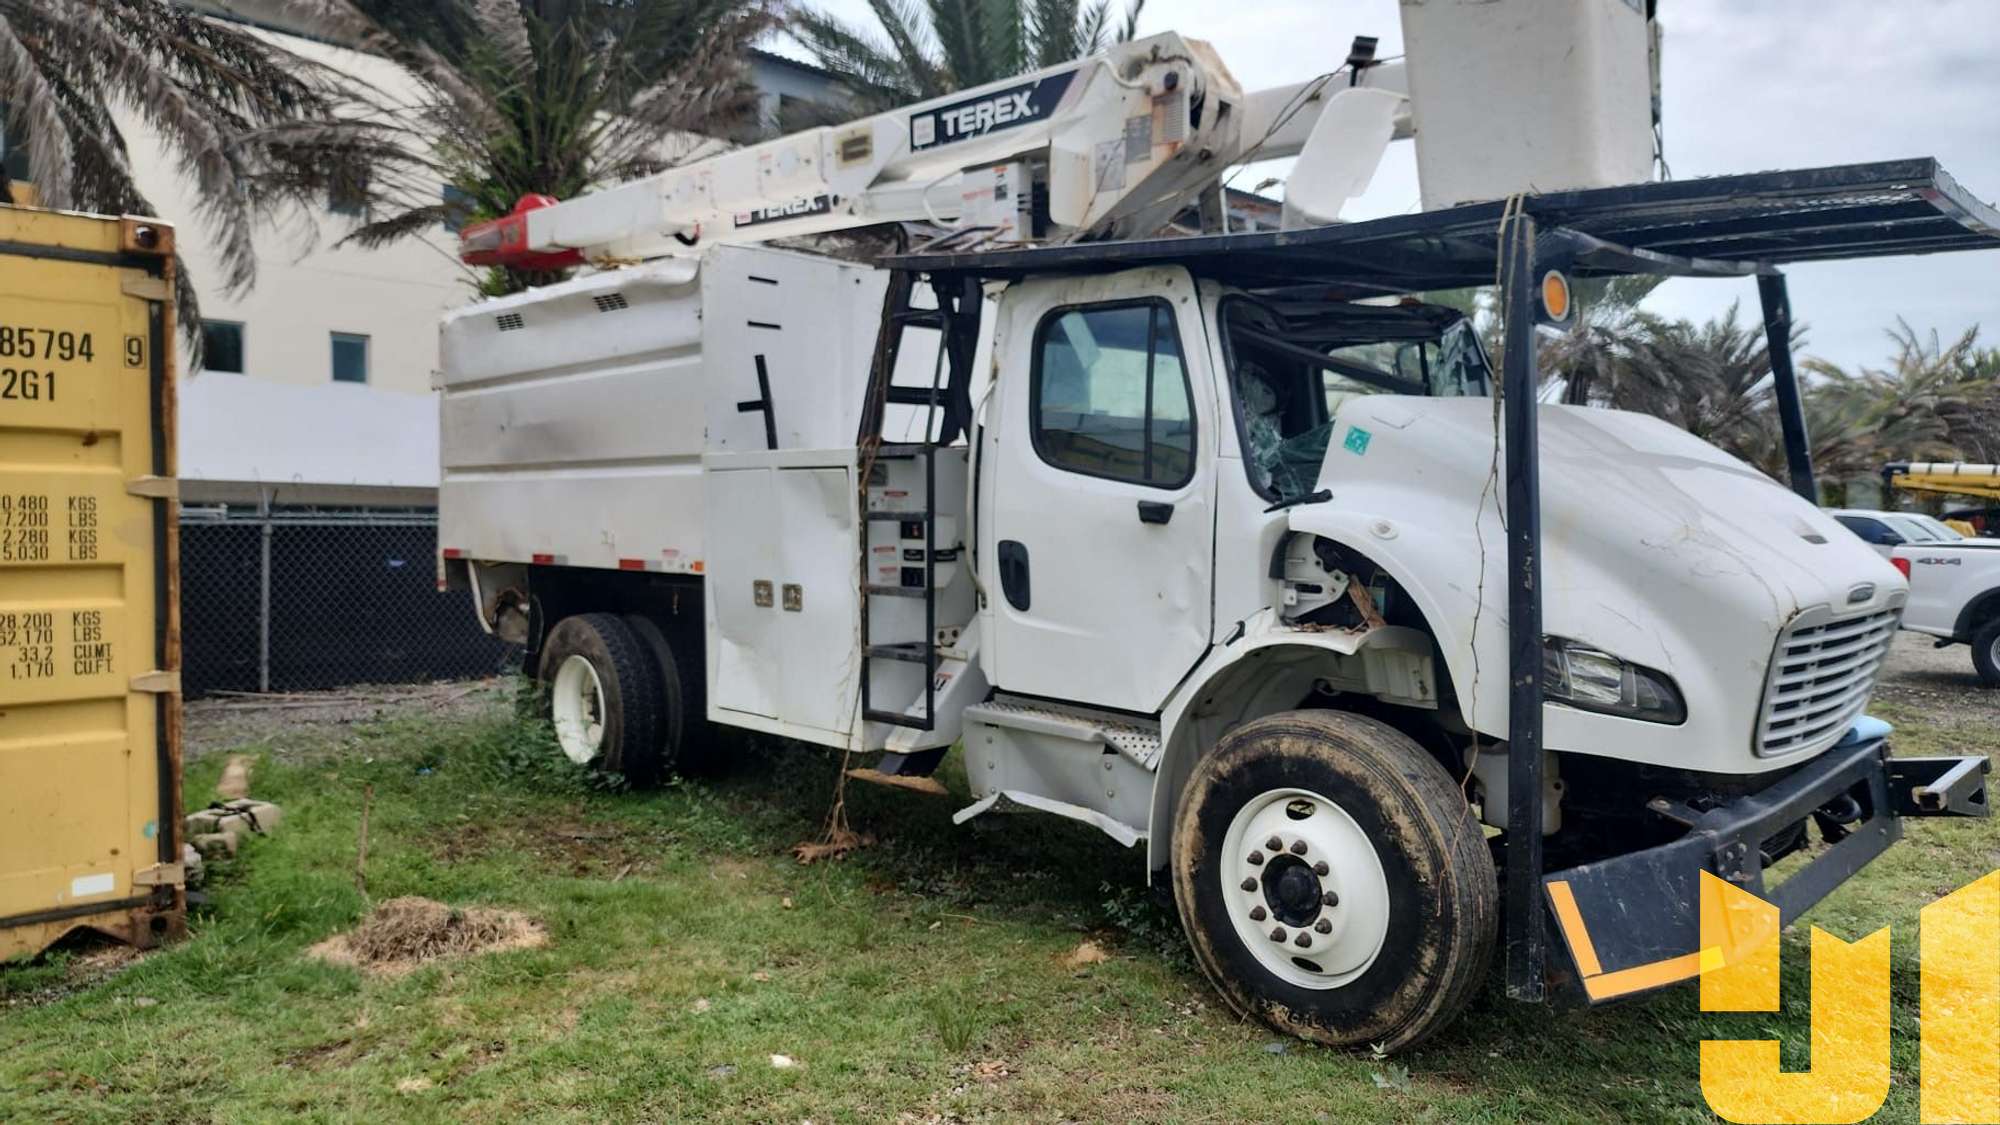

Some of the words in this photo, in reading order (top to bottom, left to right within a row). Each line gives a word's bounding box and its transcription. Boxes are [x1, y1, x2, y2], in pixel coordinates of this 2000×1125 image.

[0, 326, 94, 362] 85794
[127, 337, 143, 366] 9
[2, 368, 55, 402] 2G1
[69, 496, 97, 511] KGS
[69, 512, 97, 527] LBS
[69, 529, 97, 544] KGS
[69, 545, 98, 560] LBS
[73, 611, 101, 626] KGS
[73, 627, 101, 642] LBS
